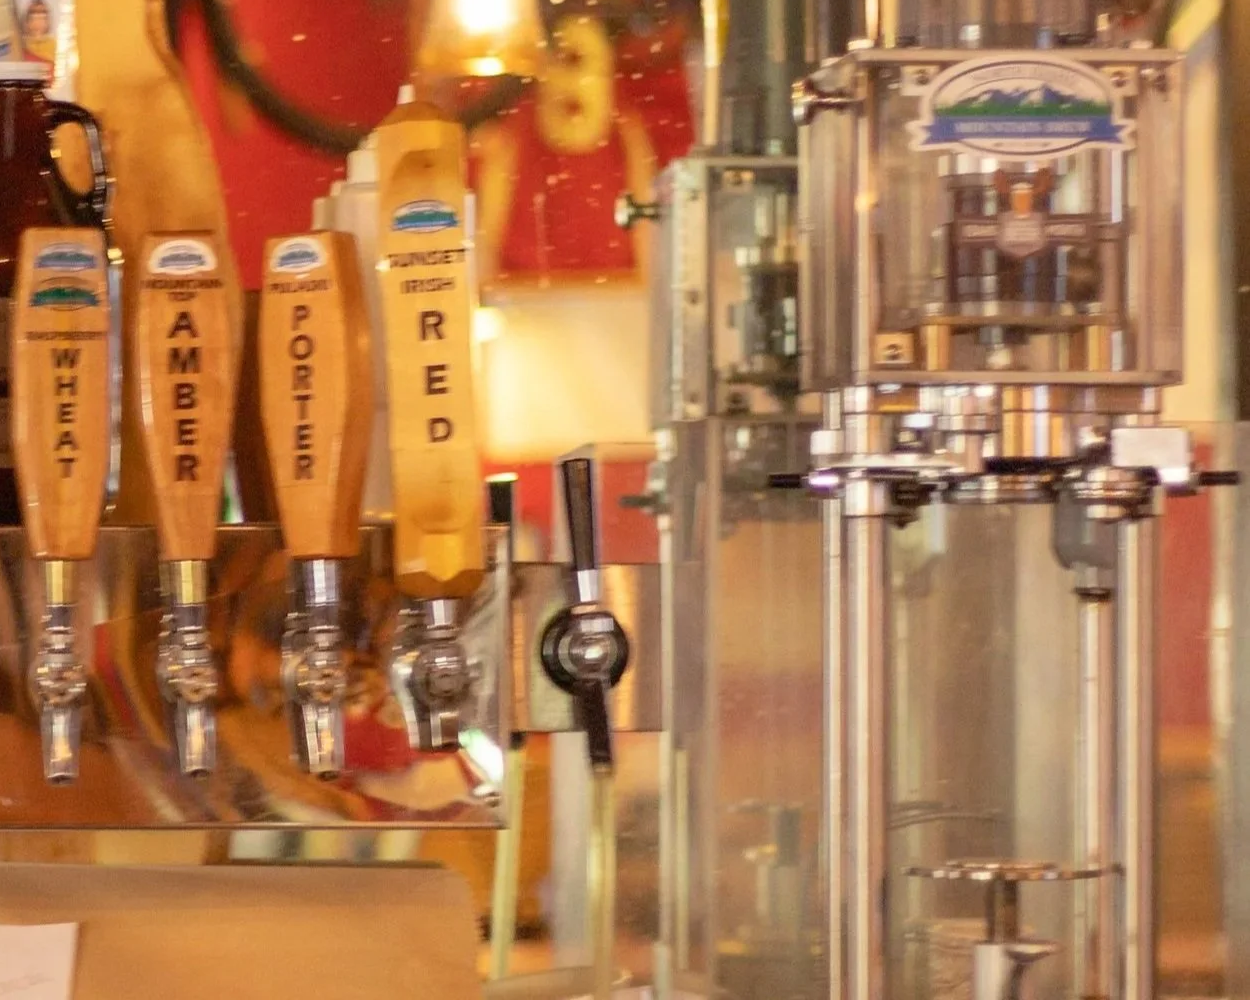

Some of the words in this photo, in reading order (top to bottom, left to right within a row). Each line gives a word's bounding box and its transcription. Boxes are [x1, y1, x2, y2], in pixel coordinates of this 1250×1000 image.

[400, 276, 456, 294] IRISH
[50, 346, 82, 480] WHEAT
[166, 309, 201, 483] AMBER
[289, 303, 317, 481] PORTER
[418, 309, 454, 443] RED
